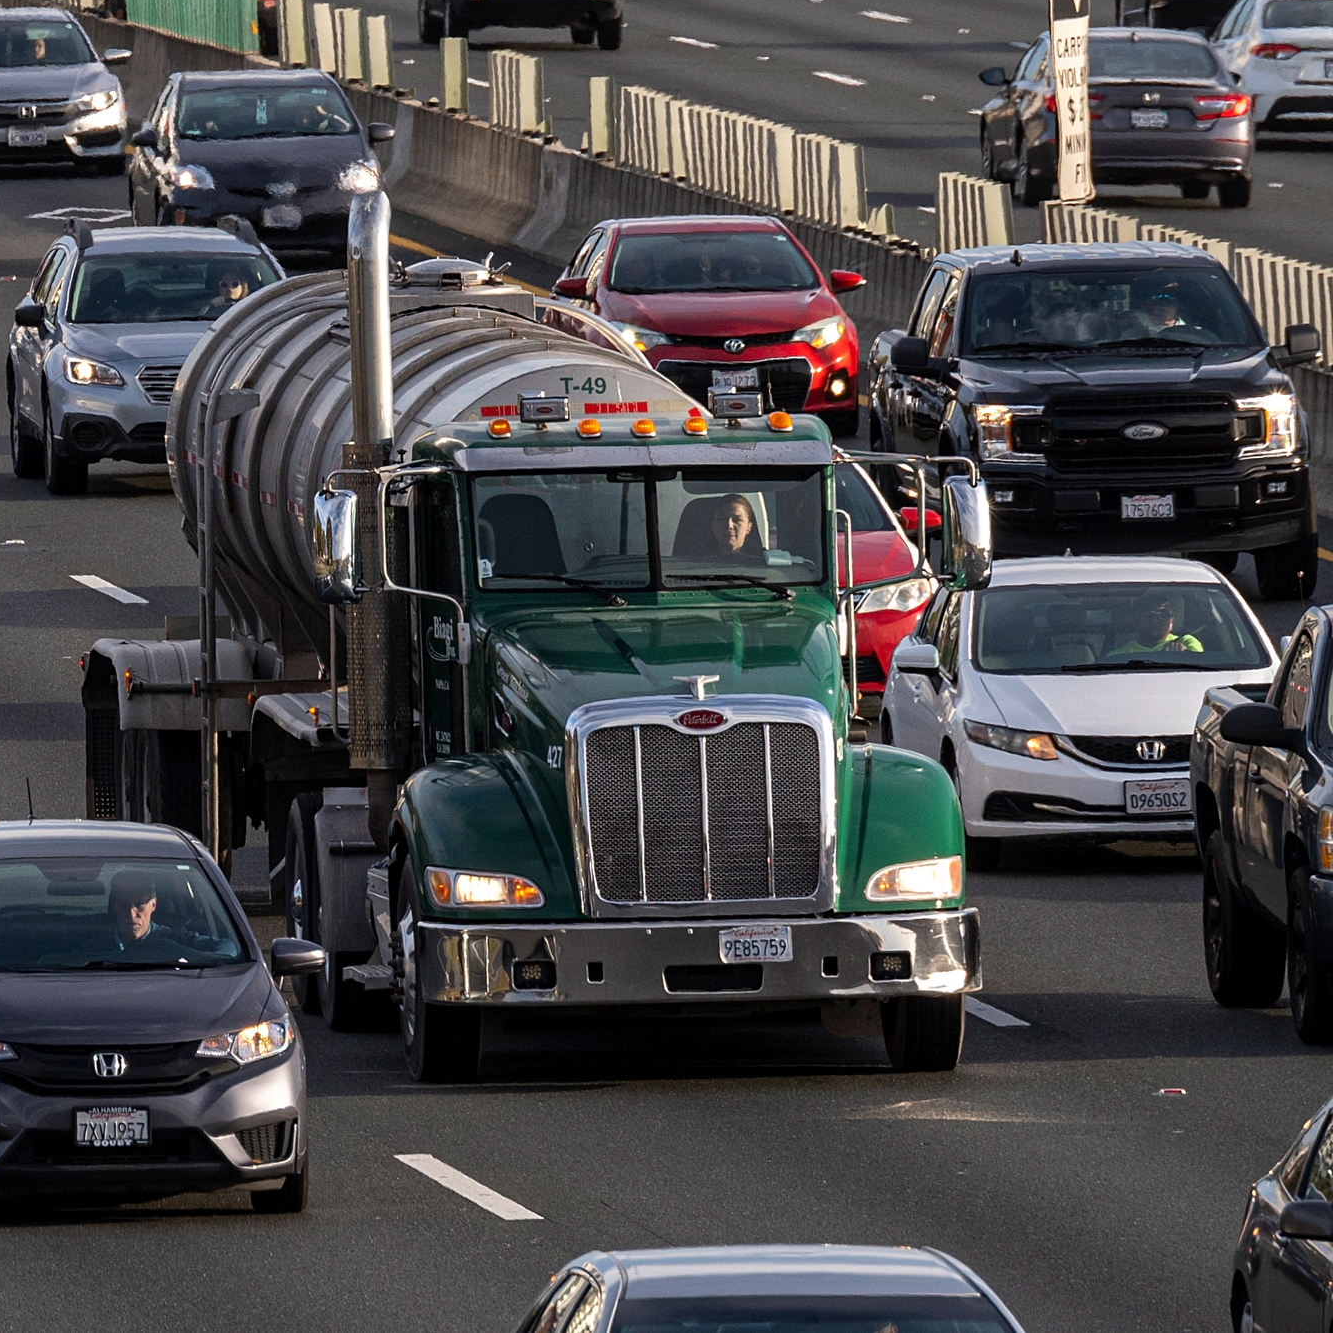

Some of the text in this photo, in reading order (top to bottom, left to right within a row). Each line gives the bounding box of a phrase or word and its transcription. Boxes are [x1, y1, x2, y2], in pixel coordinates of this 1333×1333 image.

[560, 377, 607, 395] T-49
[1131, 423, 1156, 437] Ford
[682, 713, 719, 726] Peterbilt
[547, 745, 563, 769] 427
[1139, 782, 1178, 792] California
[734, 929, 777, 939] California
[724, 938, 786, 958] 9E85759
[80, 1121, 145, 1140] 7XVJ957
